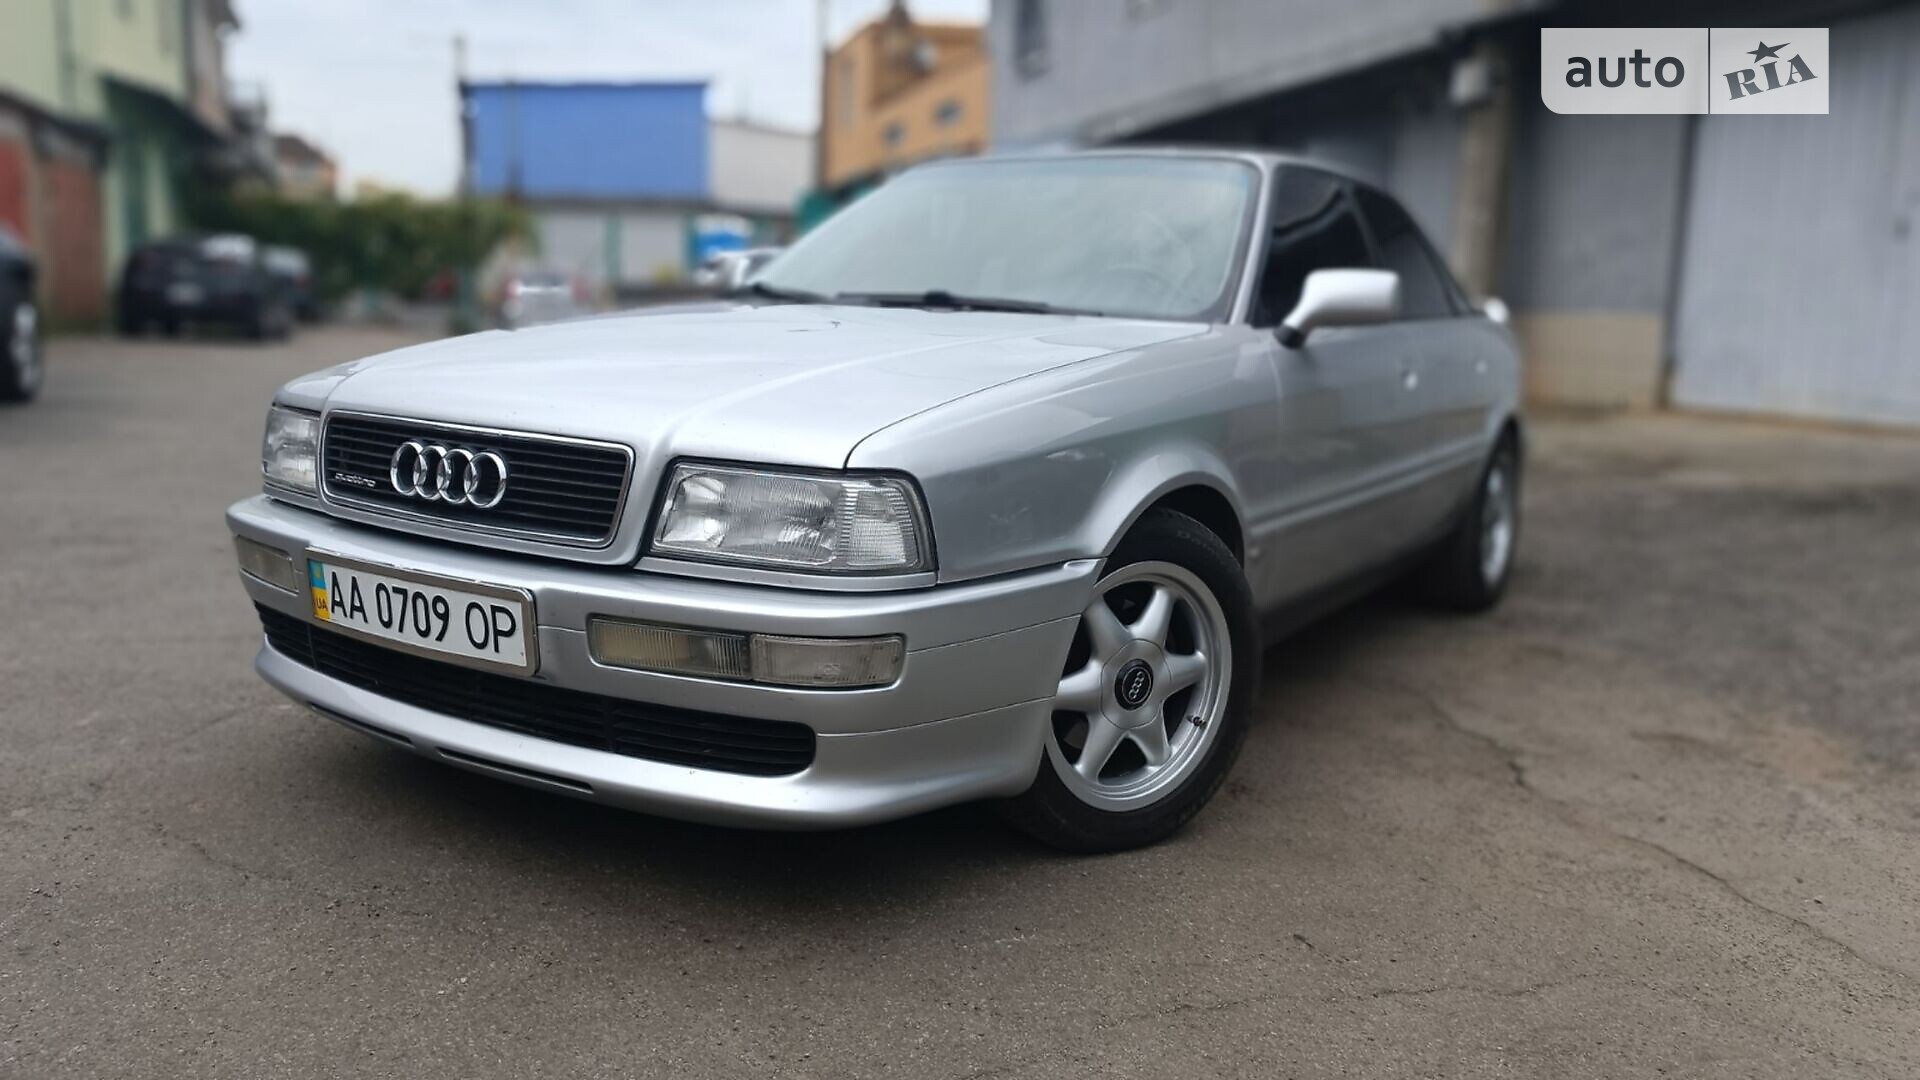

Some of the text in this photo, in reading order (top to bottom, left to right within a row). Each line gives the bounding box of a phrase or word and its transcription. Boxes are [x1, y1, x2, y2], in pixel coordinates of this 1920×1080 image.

[315, 596, 328, 610] UA
[330, 571, 517, 653] AA 0709 OP
